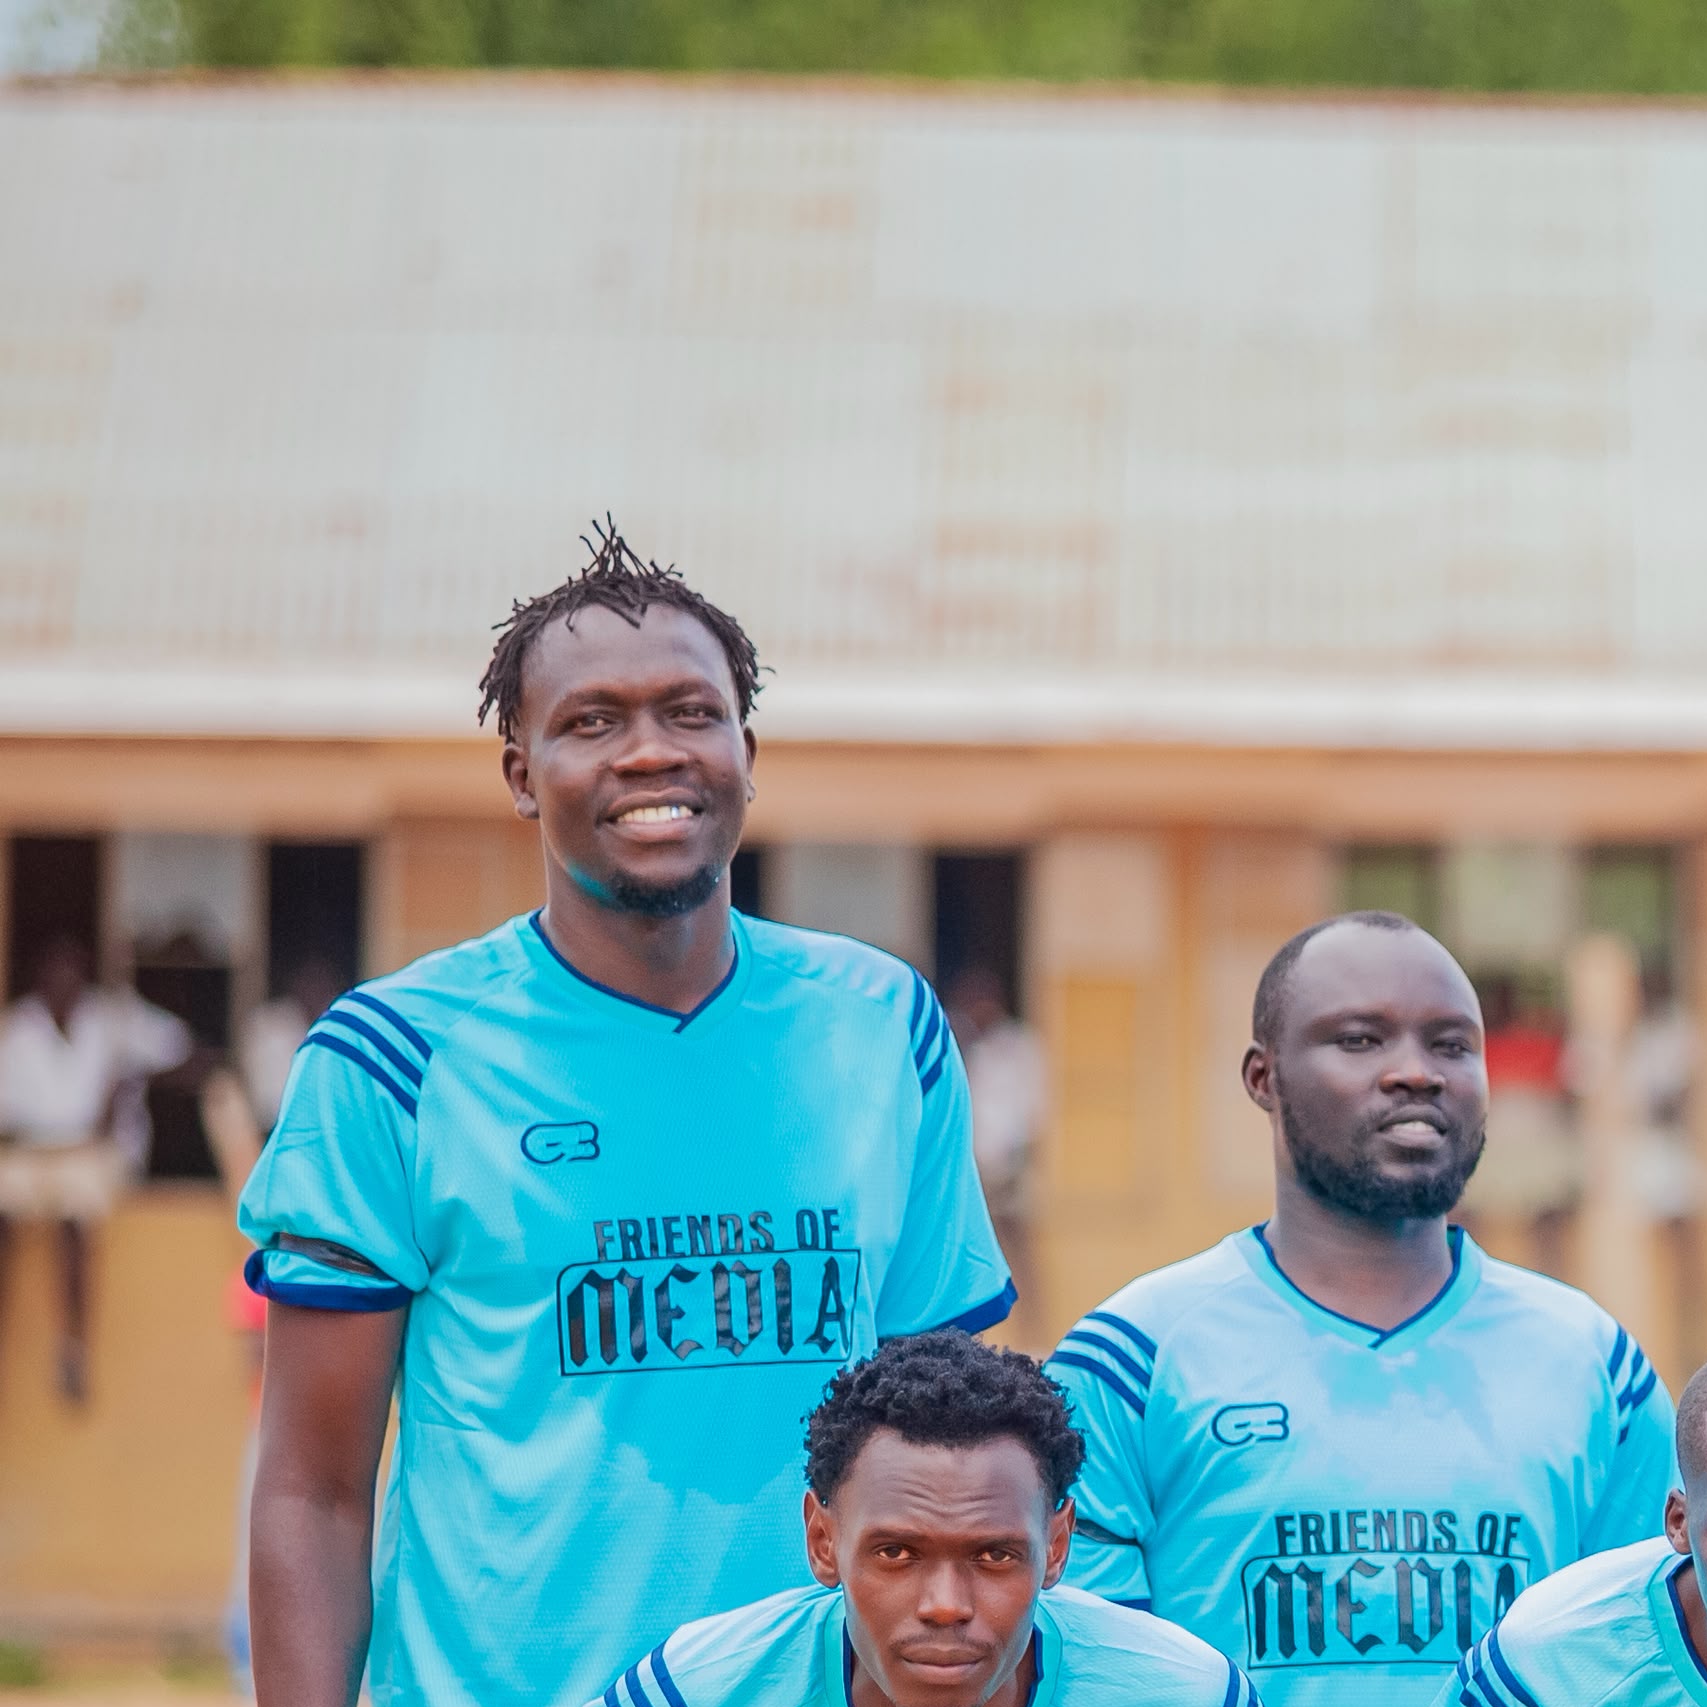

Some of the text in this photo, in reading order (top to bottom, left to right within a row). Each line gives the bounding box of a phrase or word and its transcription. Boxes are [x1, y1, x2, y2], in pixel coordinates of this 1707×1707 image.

[593, 1208, 840, 1261] FRIENDS OF
[566, 1256, 850, 1367] MEDIA
[1274, 1509, 1521, 1557] FRIENDS OF
